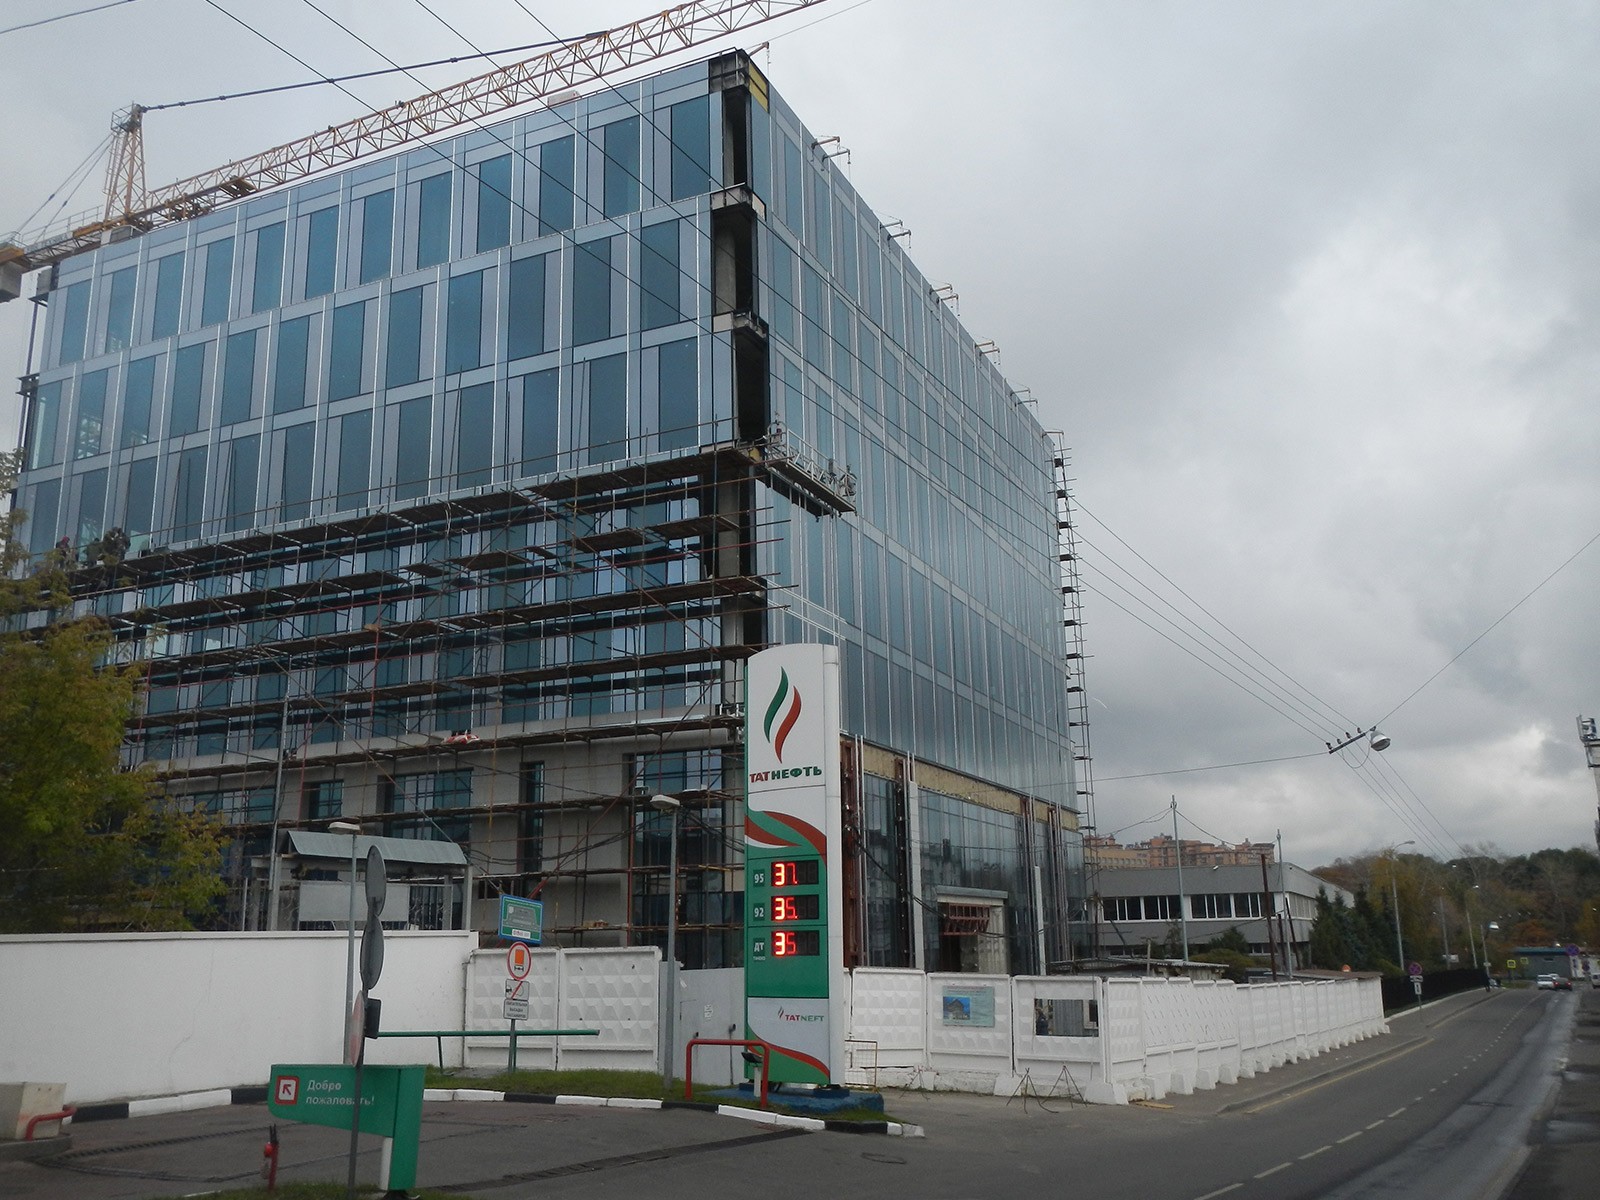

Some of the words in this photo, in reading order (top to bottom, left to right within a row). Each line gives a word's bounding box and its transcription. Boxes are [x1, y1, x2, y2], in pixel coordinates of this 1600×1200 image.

[750, 766, 822, 783] ТАТНЕФТЬ
[754, 873, 764, 884] 95
[754, 907, 764, 918] 92
[754, 942, 765, 952] ДТ
[775, 932, 796, 955] 35
[785, 1014, 825, 1022] TATNEFT
[307, 1080, 342, 1092] Добро
[305, 1095, 375, 1105] пожаловть!
